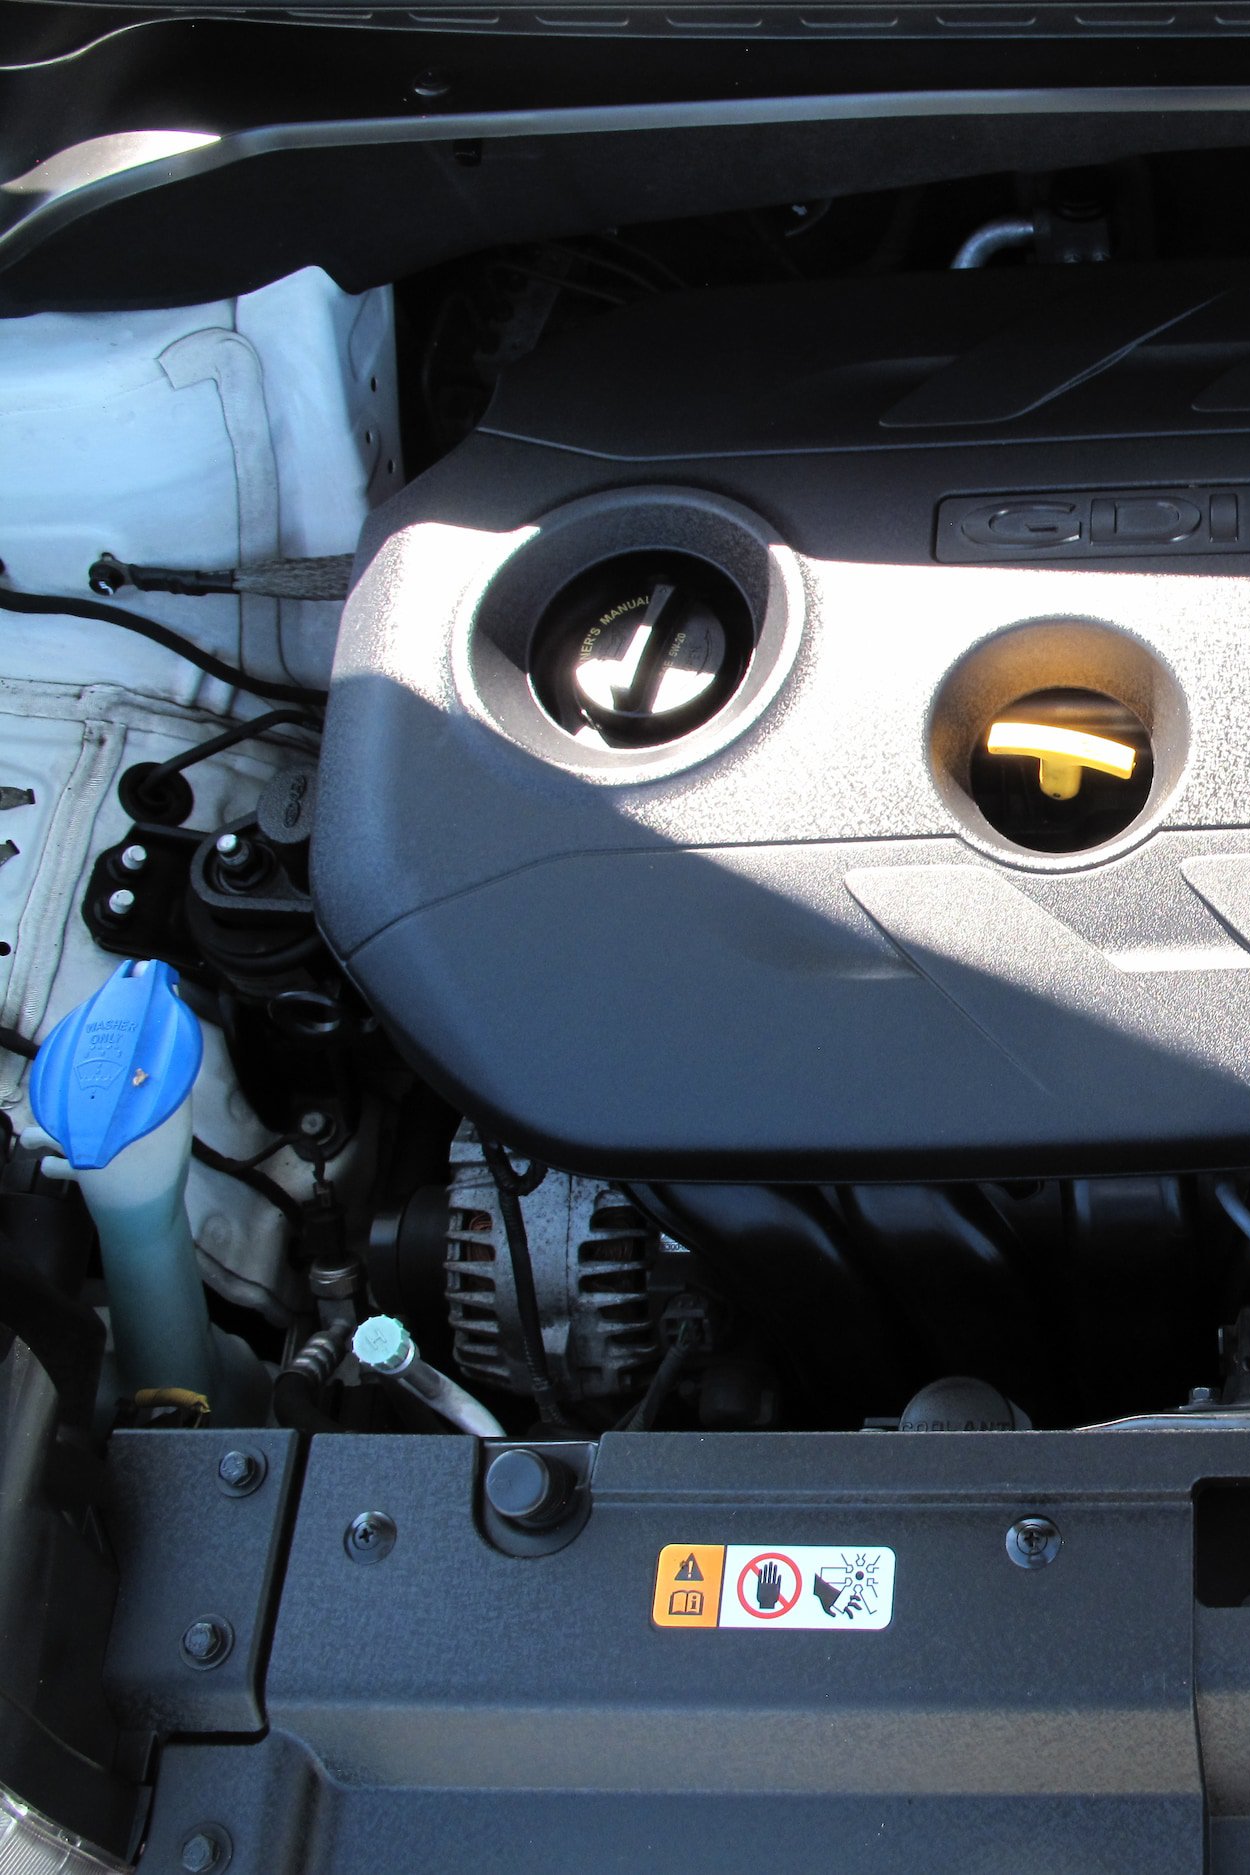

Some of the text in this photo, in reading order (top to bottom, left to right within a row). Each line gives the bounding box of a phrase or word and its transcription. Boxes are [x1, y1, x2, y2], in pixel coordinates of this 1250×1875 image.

[961, 491, 1239, 549] GDI
[579, 626, 601, 663] NER'S
[669, 632, 687, 658] 5W-20
[86, 1019, 138, 1034] WASHER
[91, 1033, 123, 1045] ONLY
